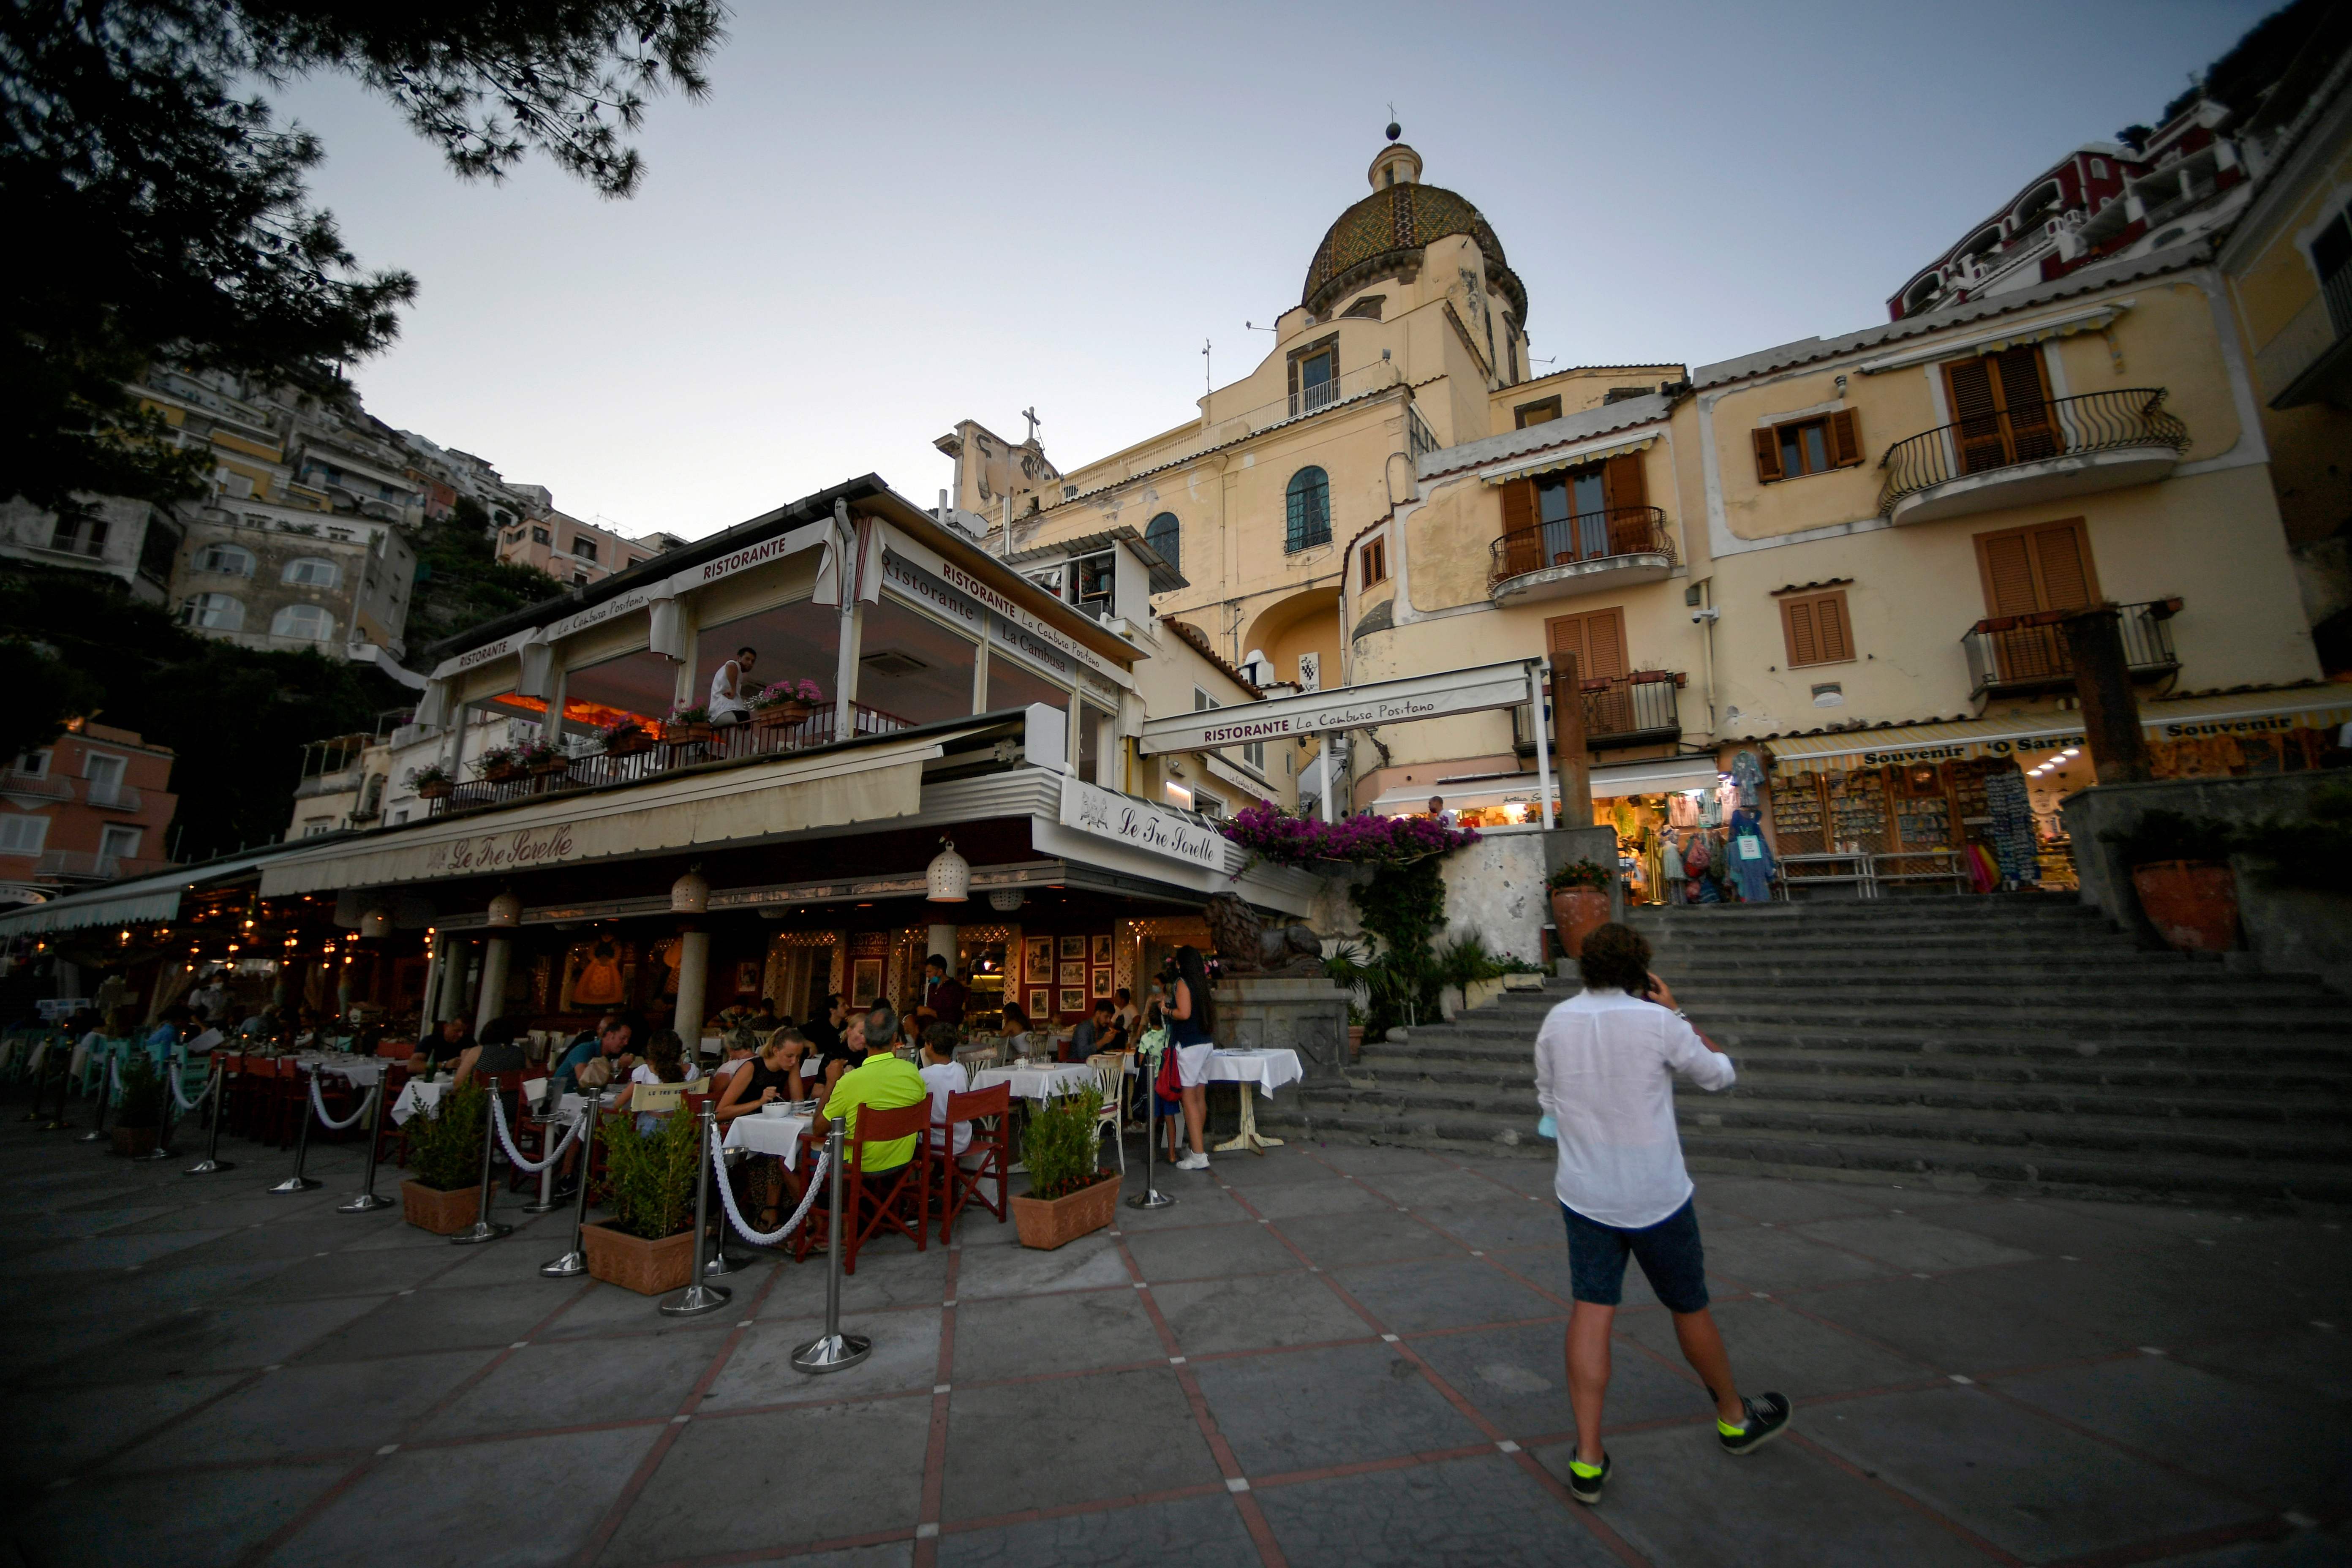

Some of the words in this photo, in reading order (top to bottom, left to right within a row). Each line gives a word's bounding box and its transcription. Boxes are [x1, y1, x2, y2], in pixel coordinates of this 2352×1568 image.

[703, 537, 786, 580] RISTORANTE
[882, 554, 973, 620] Ristorante
[558, 621, 568, 635] La
[573, 610, 606, 629] Cambusa
[610, 595, 643, 615] Positano
[944, 563, 1015, 618] RISTORANTE
[1022, 612, 1033, 628] La
[1037, 623, 1069, 650] Cambusa
[1072, 642, 1100, 668] Positano
[459, 641, 507, 667] RISTORANTE
[1002, 623, 1016, 645] La
[1020, 635, 1066, 672] Cambusa
[1205, 720, 1289, 742] RISTORANTE
[1296, 717, 1312, 730] La
[1320, 710, 1373, 726] Cambusa
[1379, 701, 1434, 718] Positano
[2167, 716, 2292, 737] Souvenir
[1864, 746, 1965, 764] Souvenir
[448, 838, 473, 870] Le
[476, 836, 505, 867] Tre
[507, 824, 573, 863] Sorelle
[1118, 808, 1140, 838] Le
[1143, 817, 1169, 847] Tre
[1171, 827, 1214, 862] Sorelle
